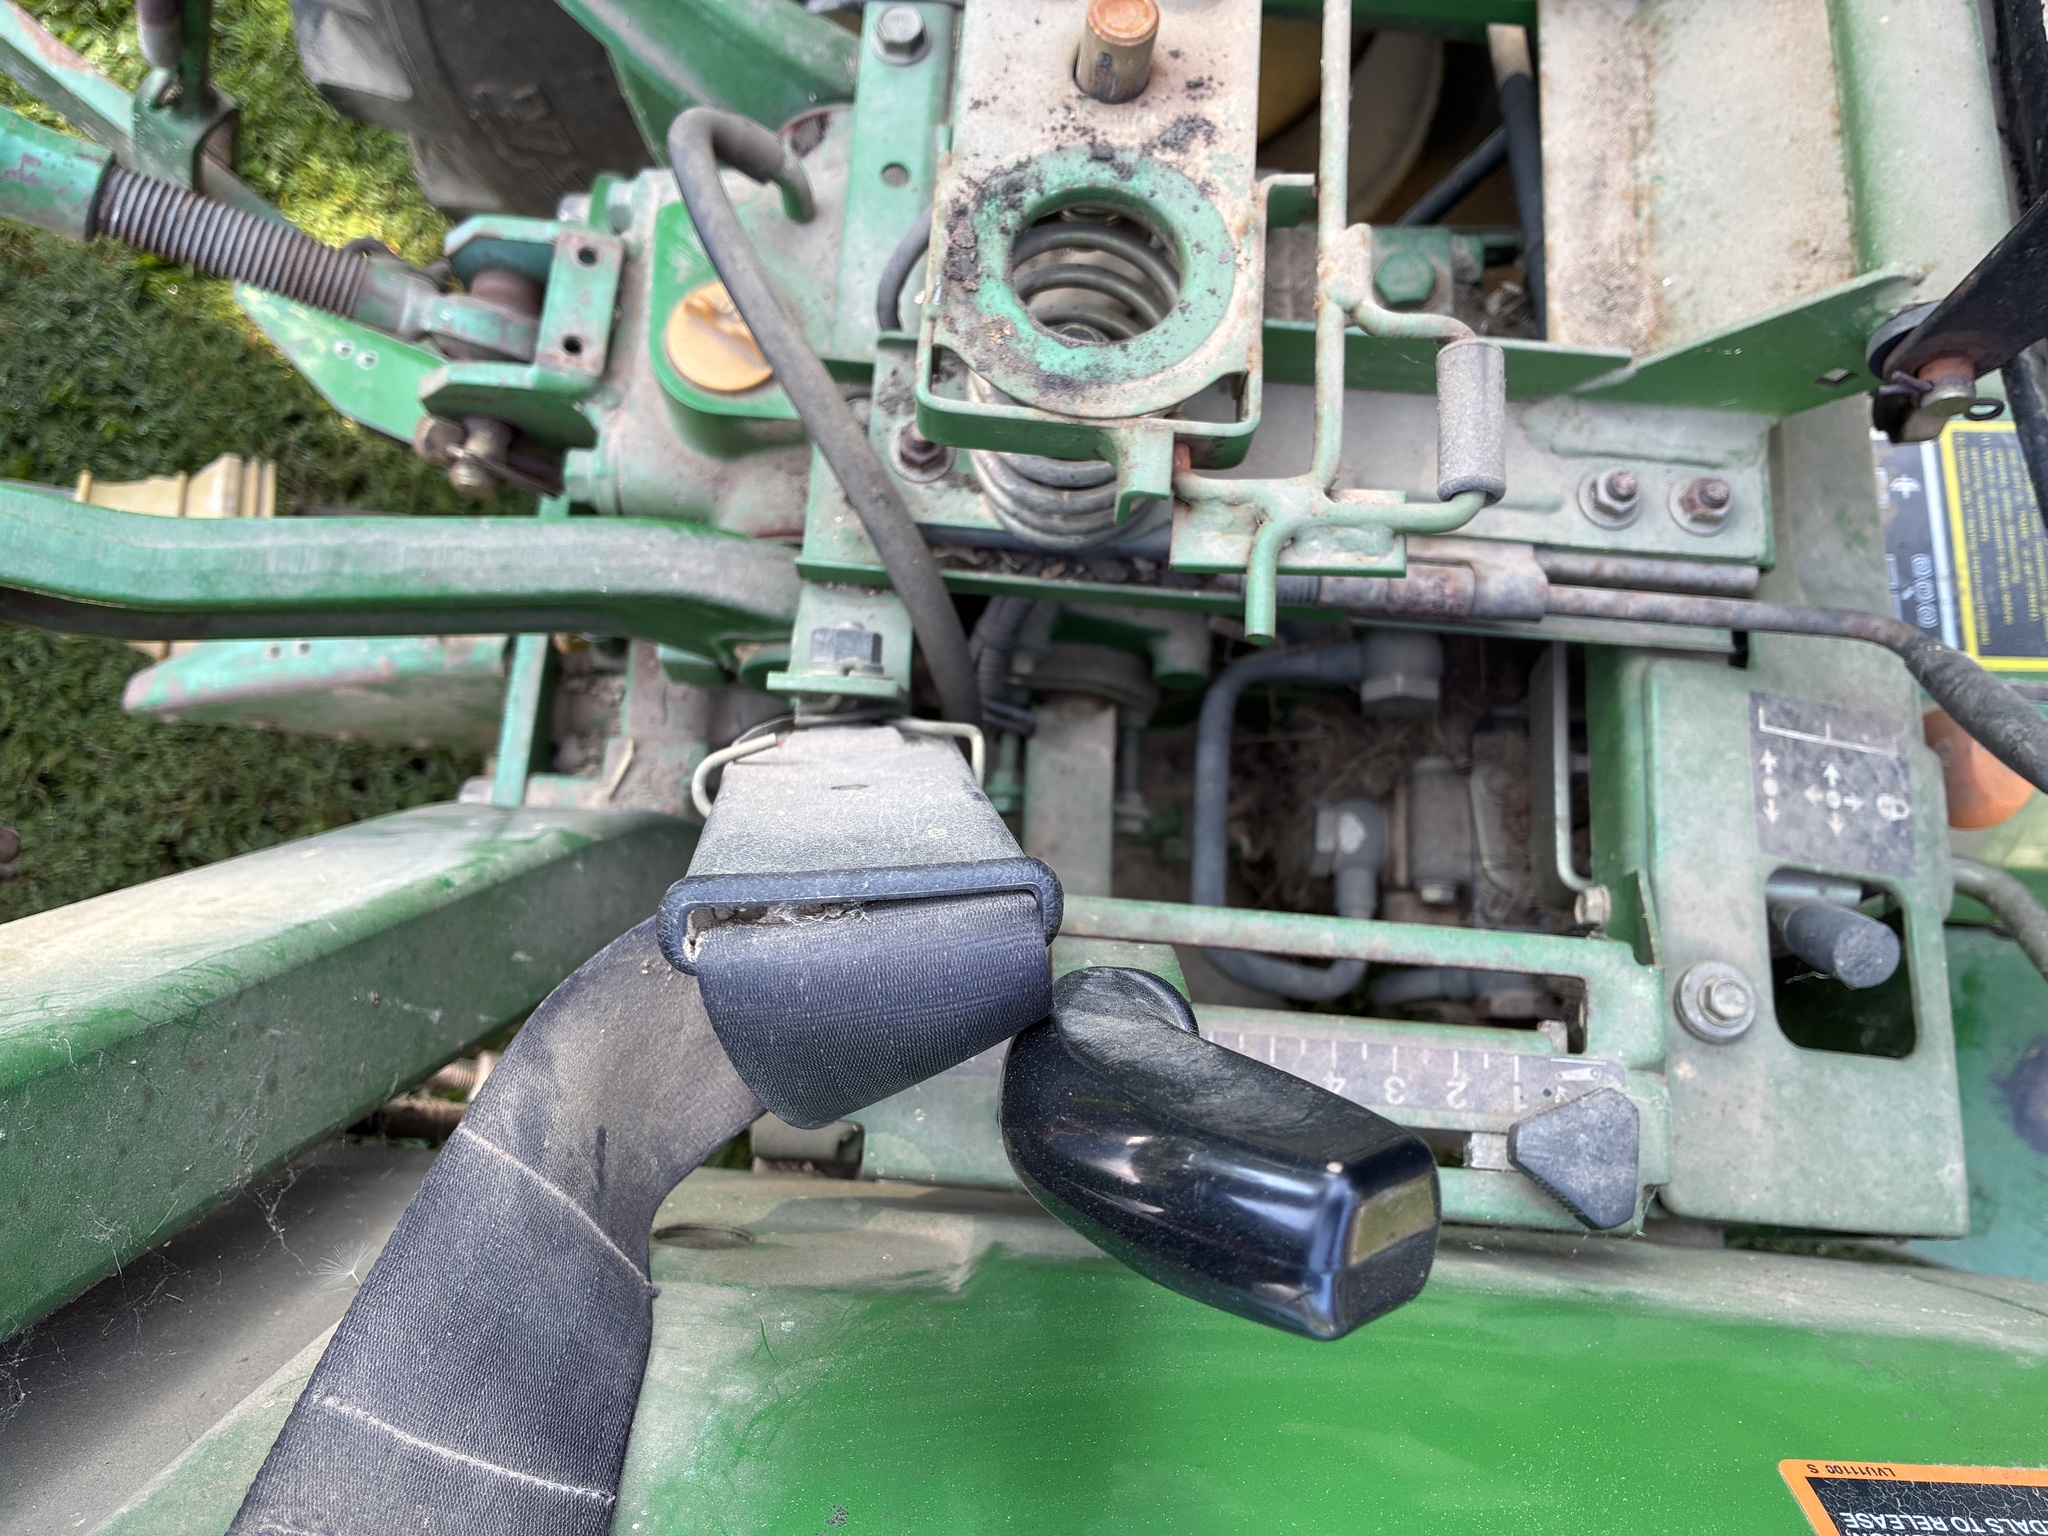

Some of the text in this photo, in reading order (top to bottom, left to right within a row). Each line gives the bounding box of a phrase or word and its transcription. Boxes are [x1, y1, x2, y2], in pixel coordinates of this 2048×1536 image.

[1322, 1071, 1528, 1113] 1 2 3 4
[1807, 1463, 1819, 1474] S
[1840, 1512, 2048, 1535] DALS TO RELEASE
